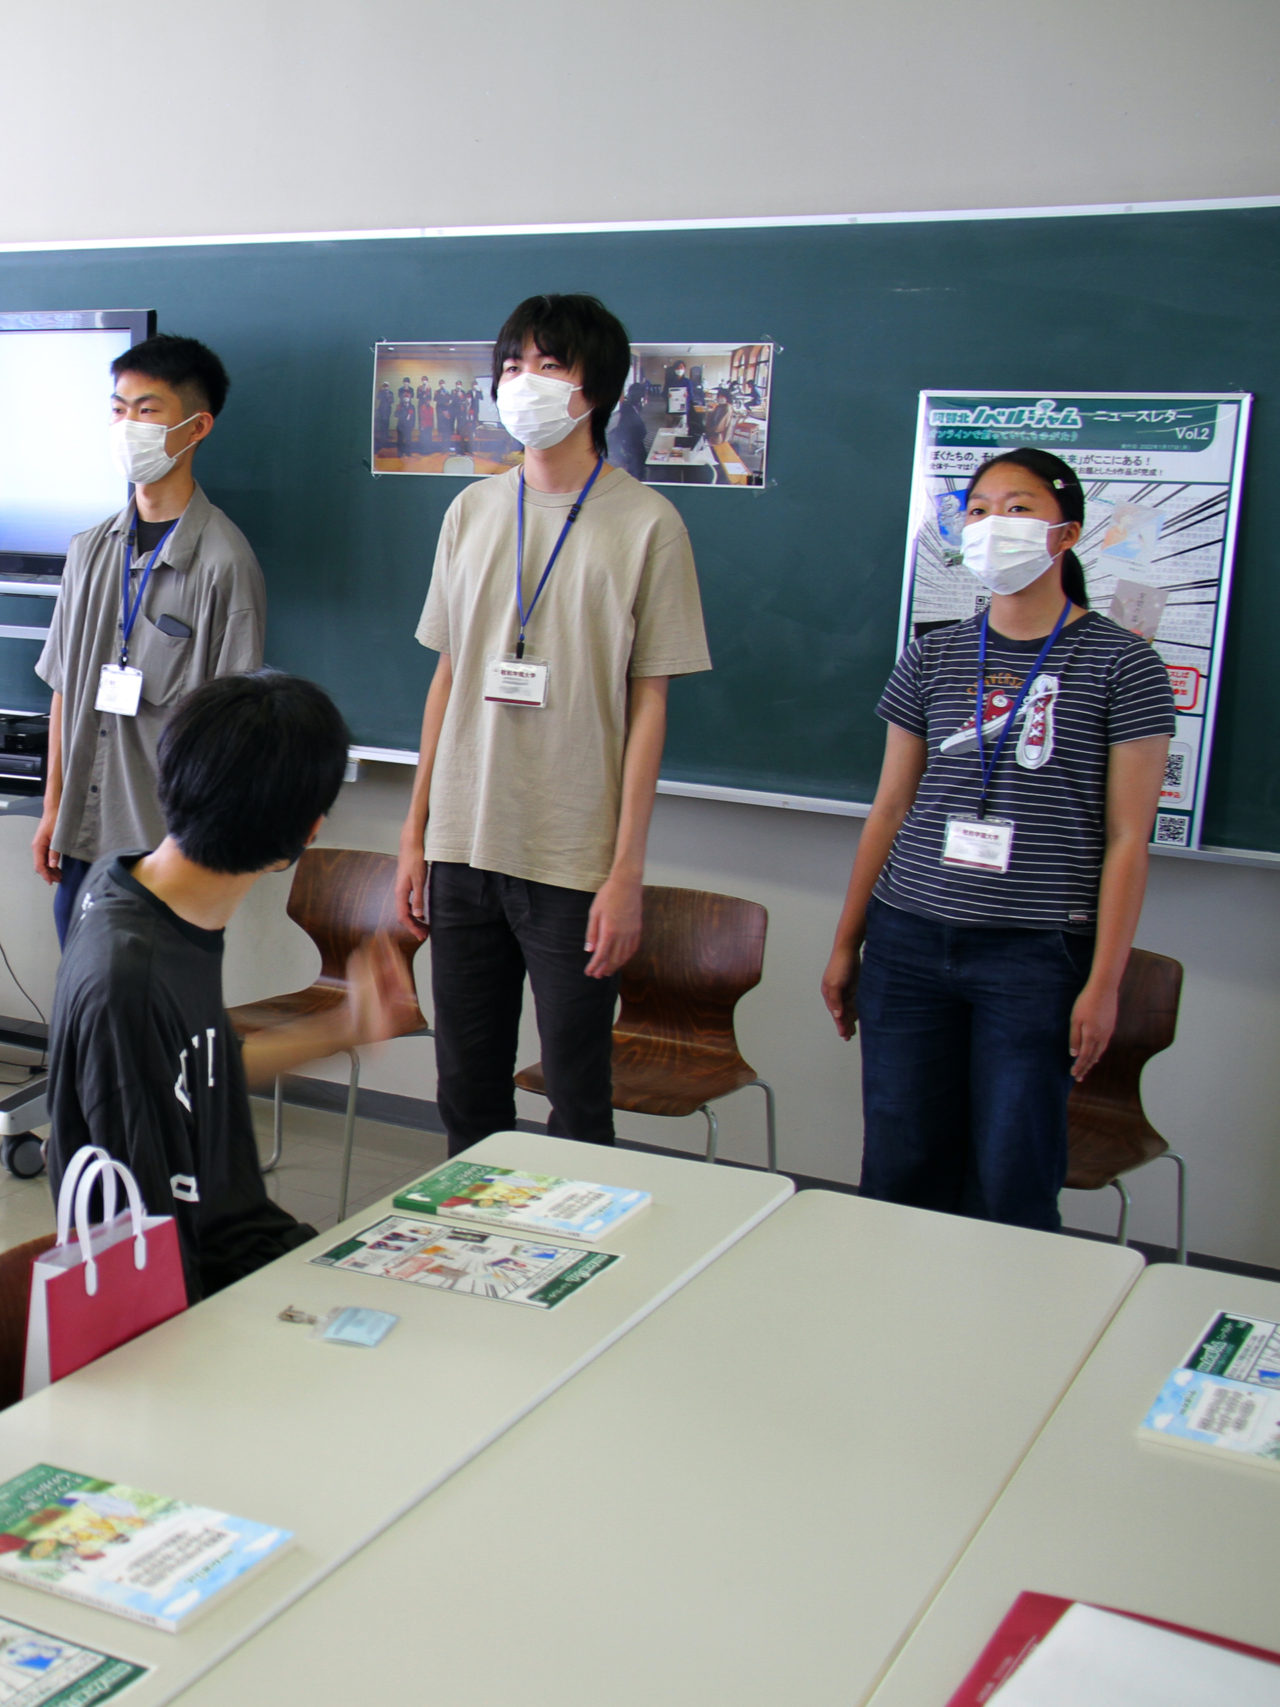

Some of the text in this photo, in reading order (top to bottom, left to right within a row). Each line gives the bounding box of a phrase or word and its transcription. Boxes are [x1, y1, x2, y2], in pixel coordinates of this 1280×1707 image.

[1093, 410, 1193, 423] ニュースレター
[1175, 427, 1209, 440] Vol.2
[966, 672, 1024, 695] CNVERS
